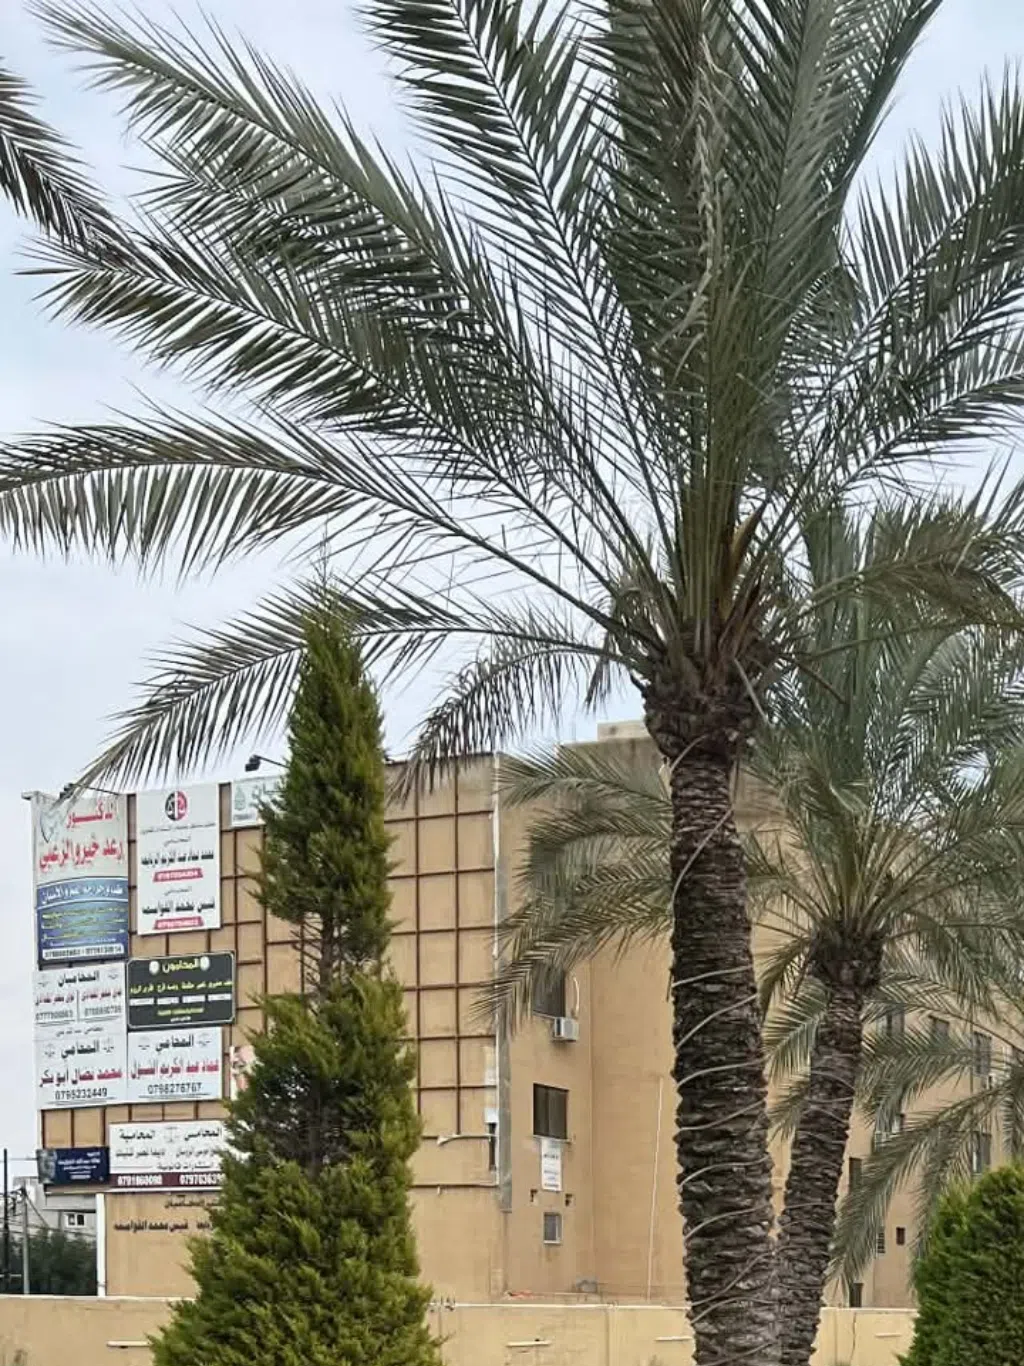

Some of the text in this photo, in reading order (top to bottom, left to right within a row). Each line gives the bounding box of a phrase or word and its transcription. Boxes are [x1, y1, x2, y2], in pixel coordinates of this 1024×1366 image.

[61, 1040, 99, 1061] المحامي
[155, 1033, 194, 1055] المحامي
[97, 1068, 122, 1080] محمد
